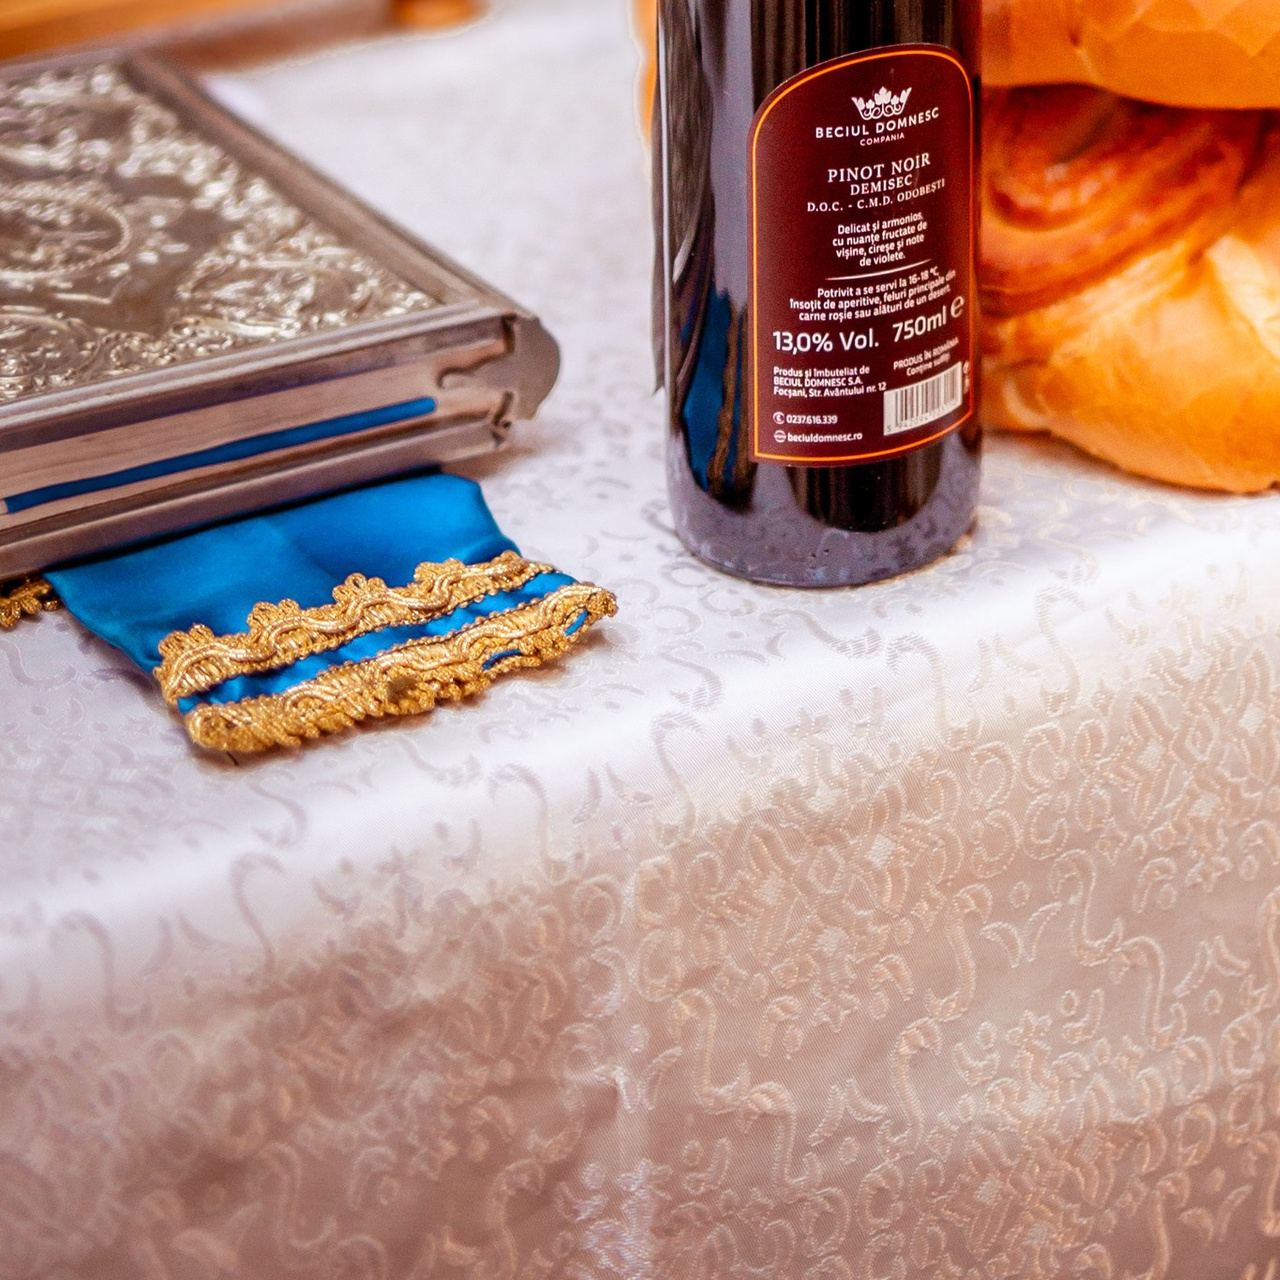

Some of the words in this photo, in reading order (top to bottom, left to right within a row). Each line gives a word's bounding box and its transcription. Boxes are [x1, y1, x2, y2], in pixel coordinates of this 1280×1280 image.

[815, 124, 869, 139] BECIUL
[875, 107, 939, 134] DOMNESC
[859, 132, 905, 146] COMPANIA
[827, 163, 885, 183] PINOT
[891, 152, 931, 175] NOIR
[850, 174, 913, 196] DEMISEC
[807, 201, 844, 212] D.O.C.
[856, 195, 894, 209] C.M.D.
[832, 237, 844, 247] cu
[881, 224, 916, 241] fructate
[917, 221, 928, 233] de
[837, 222, 870, 235] Delicat
[905, 233, 925, 247] note
[859, 256, 872, 268] de
[873, 250, 906, 266] violete.
[817, 286, 854, 299] Potrivit
[855, 287, 862, 297] a
[863, 285, 874, 296] se
[875, 278, 898, 294] servi
[899, 277, 908, 288] la
[908, 271, 930, 286] 16-18
[798, 312, 827, 322] carne
[854, 308, 872, 319] sau
[903, 297, 915, 310] de
[915, 294, 928, 306] un
[823, 299, 836, 310] de
[837, 296, 883, 314] aperitive,
[883, 288, 907, 303] feluri
[772, 330, 834, 356] 13,0%
[839, 327, 880, 351] Vol.
[892, 304, 947, 343] 750ml
[893, 353, 924, 371] PRODUS
[773, 366, 803, 378] Produs
[858, 365, 871, 375] de
[773, 376, 803, 387] BECIUL
[804, 377, 847, 388] DOMNESC
[877, 381, 888, 392] 12
[787, 433, 864, 443] beciuldomnesc.ro
